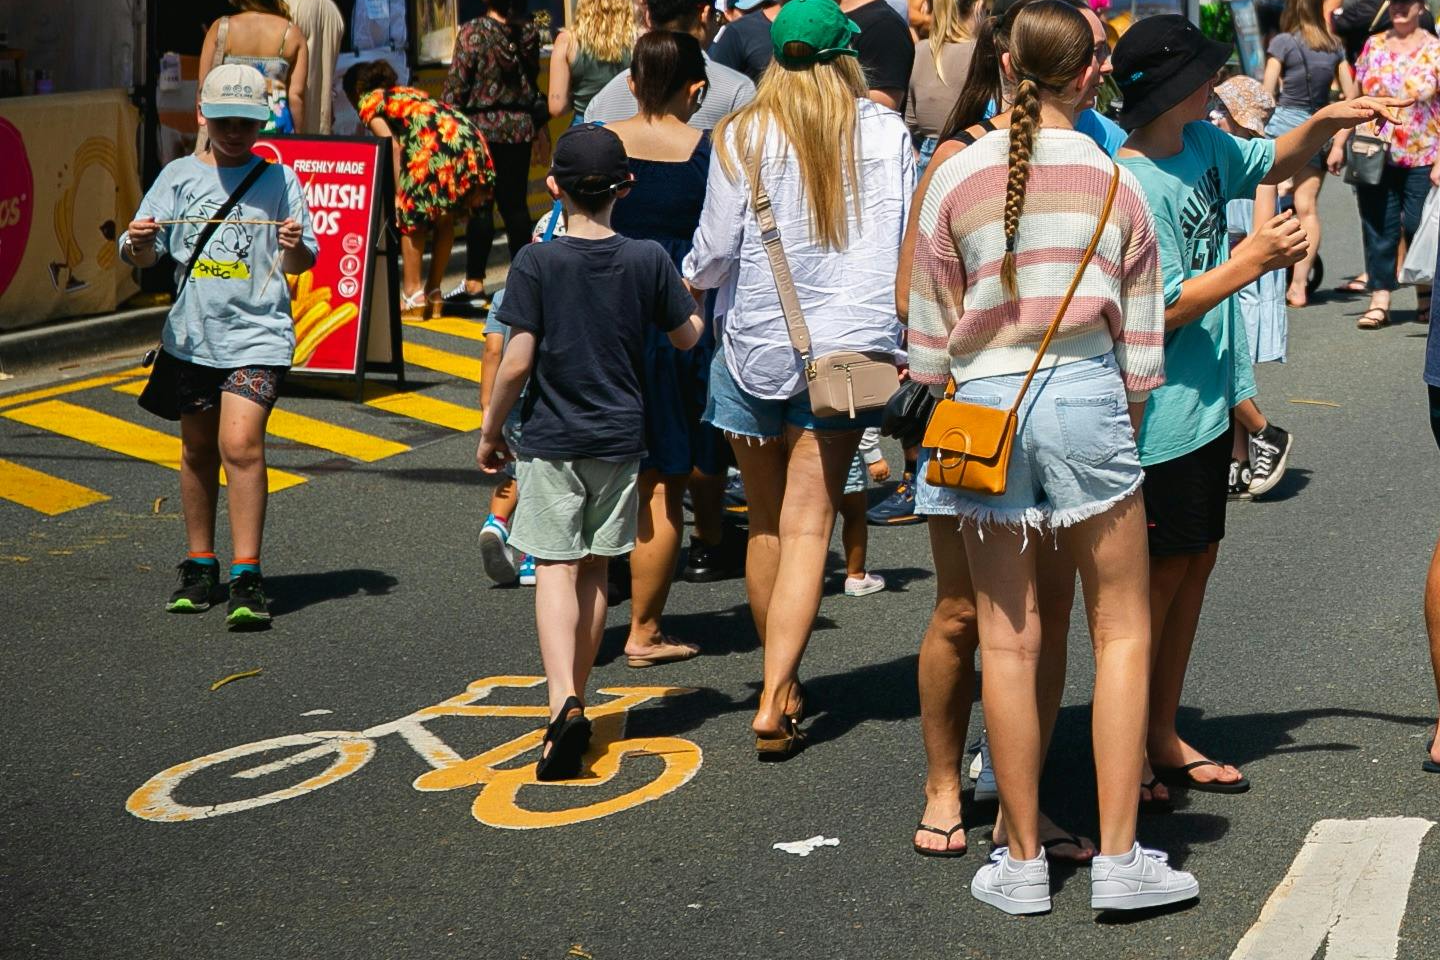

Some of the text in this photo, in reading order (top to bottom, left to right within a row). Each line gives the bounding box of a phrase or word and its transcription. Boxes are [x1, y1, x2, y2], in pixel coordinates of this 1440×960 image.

[294, 159, 365, 175] FRESHLY MADE
[310, 211, 342, 236] OS
